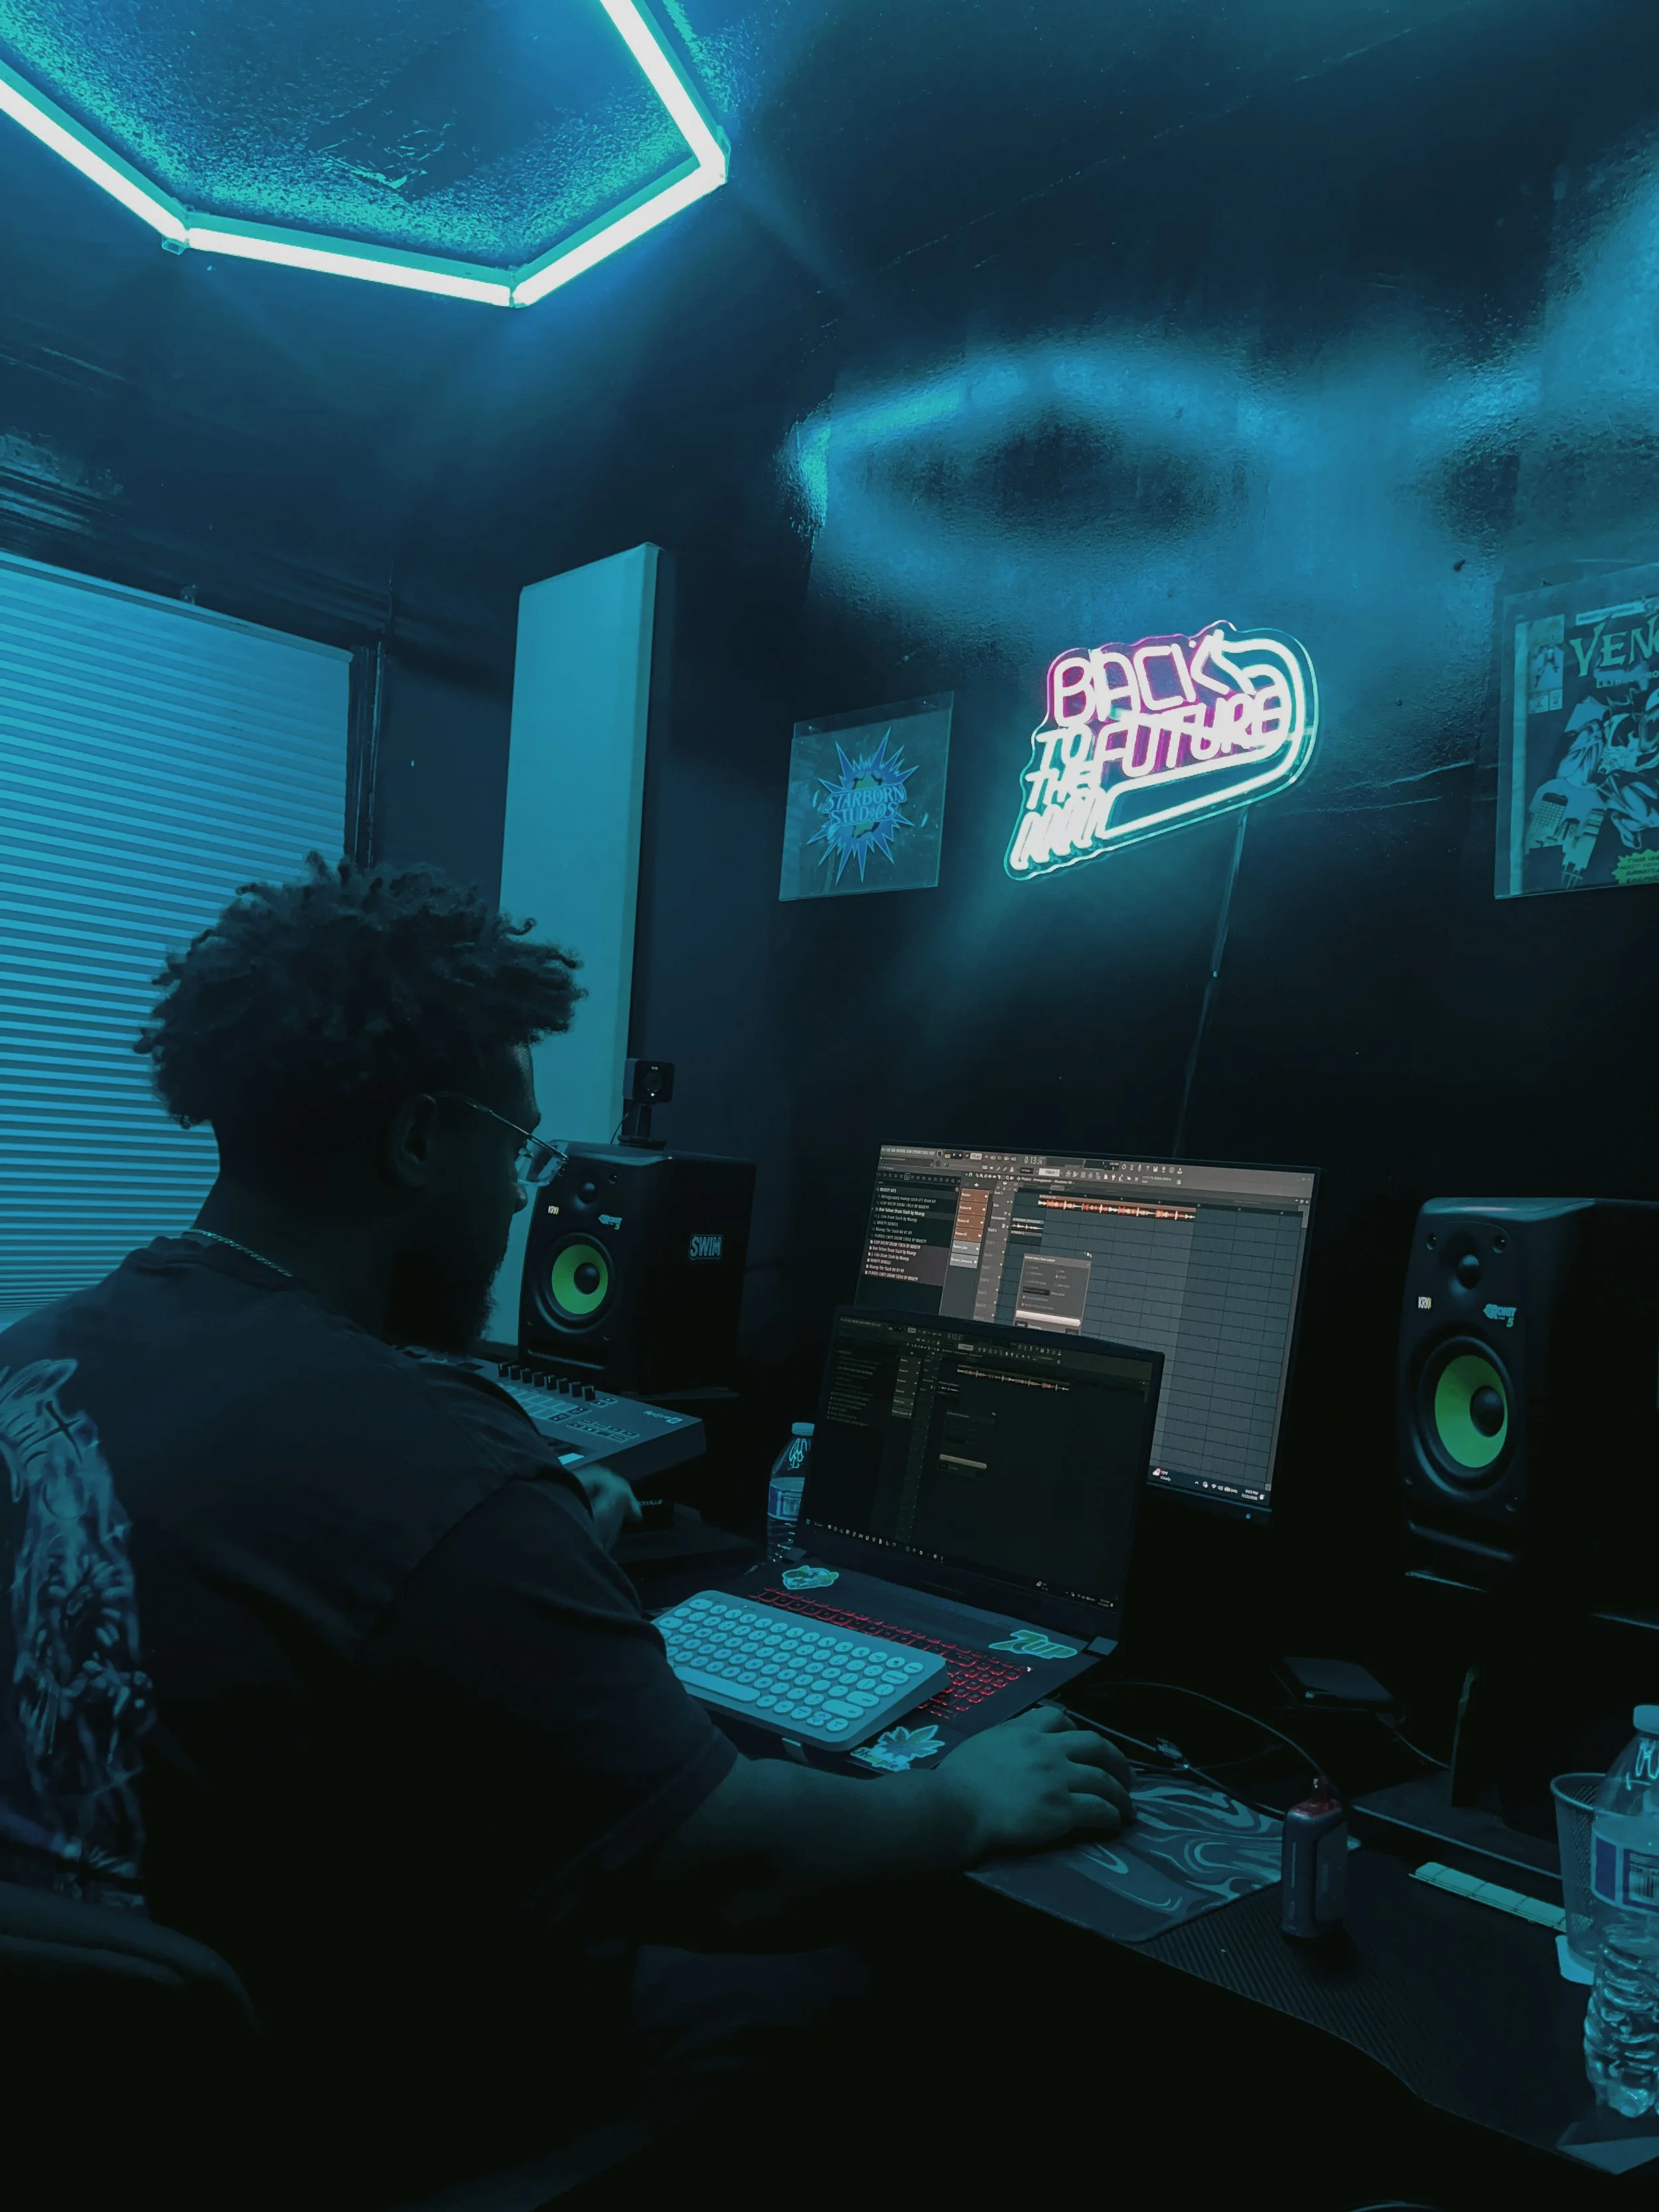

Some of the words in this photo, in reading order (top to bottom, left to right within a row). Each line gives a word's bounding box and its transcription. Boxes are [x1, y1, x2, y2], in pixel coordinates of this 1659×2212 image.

[1569, 614, 1659, 677] VEN
[1054, 629, 1256, 727] BACK
[1035, 727, 1093, 771] TO
[1095, 688, 1291, 791] FUTURE
[826, 784, 906, 811] STARBORN
[1026, 759, 1100, 810] THE
[690, 1236, 721, 1257] SWIM
[1418, 1297, 1431, 1309] KRK
[988, 1630, 1077, 1659] 7UP
